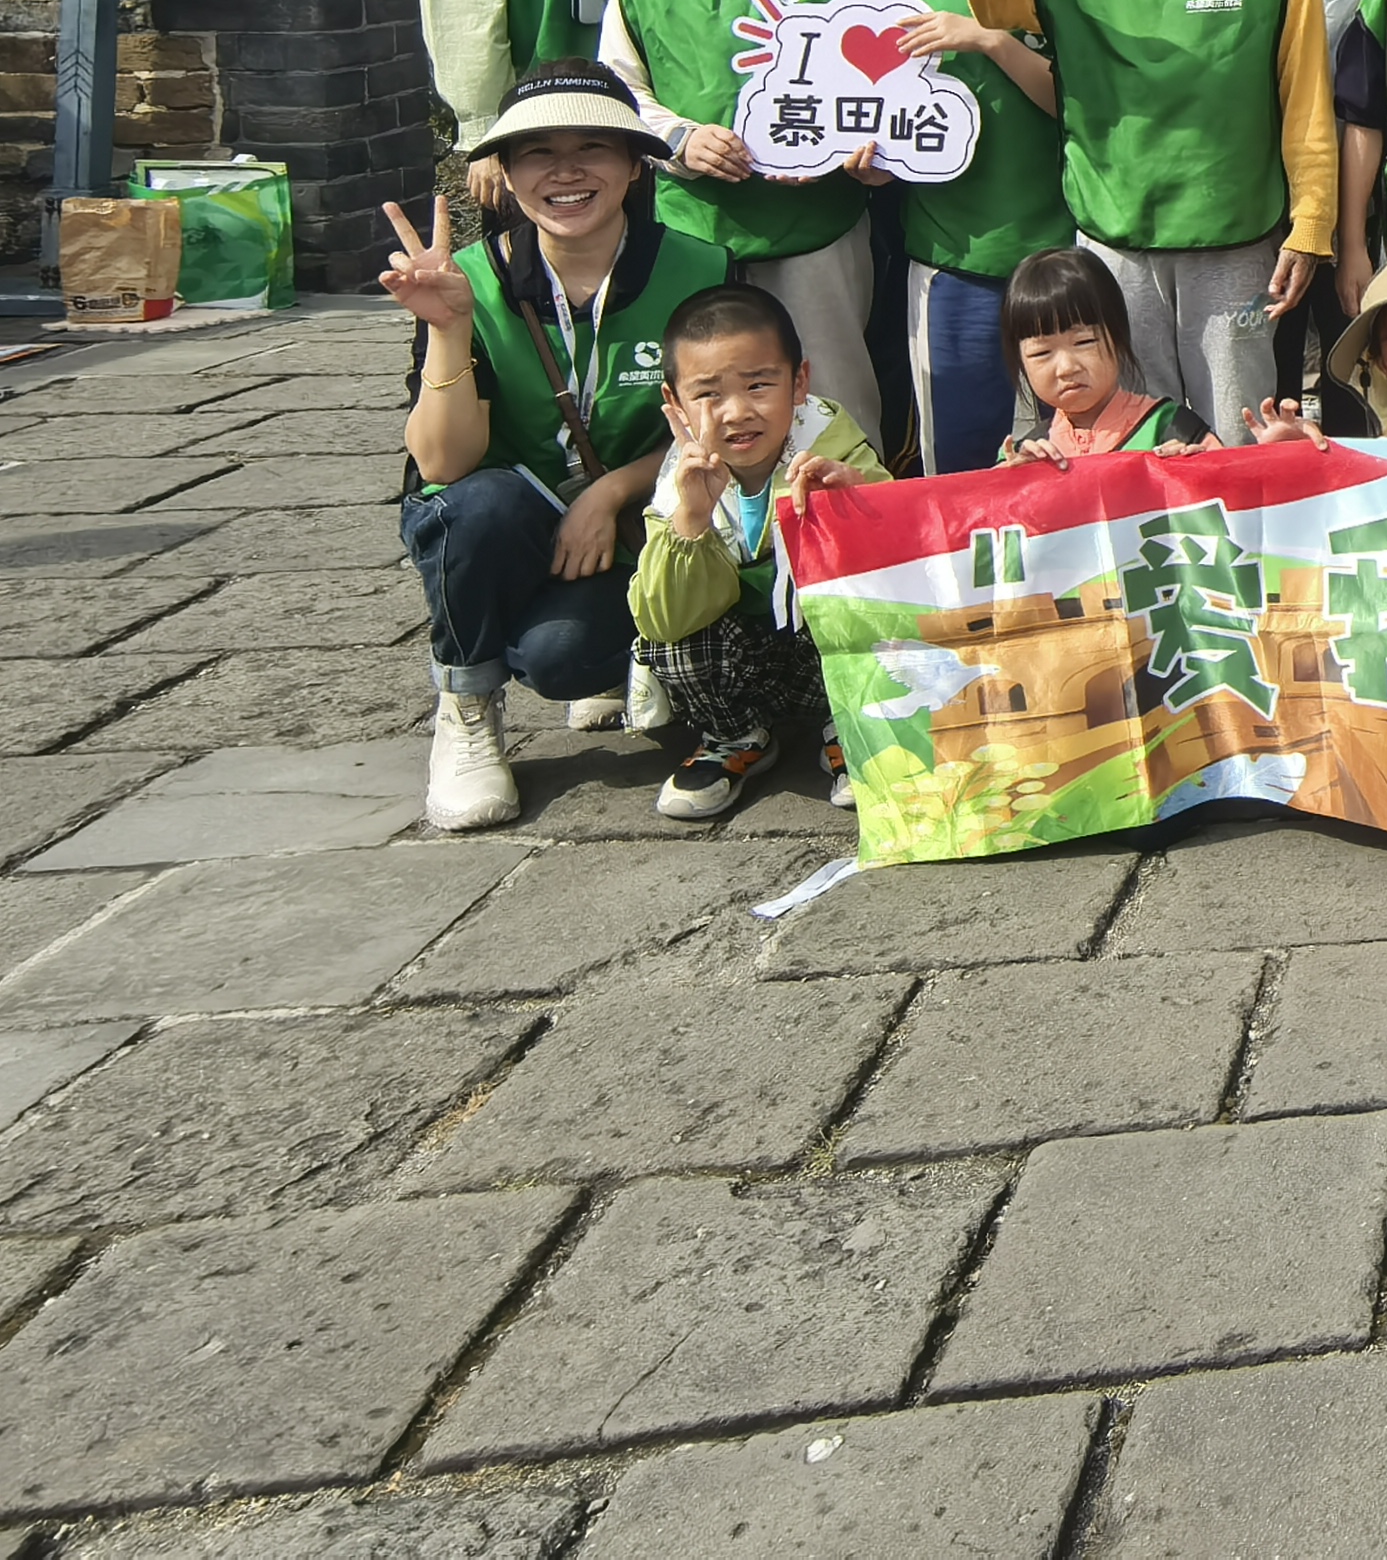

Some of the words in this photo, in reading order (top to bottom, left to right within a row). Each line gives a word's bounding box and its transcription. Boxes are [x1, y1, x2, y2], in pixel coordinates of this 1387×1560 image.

[788, 32, 821, 86] I
[768, 93, 949, 153] 慕田峪
